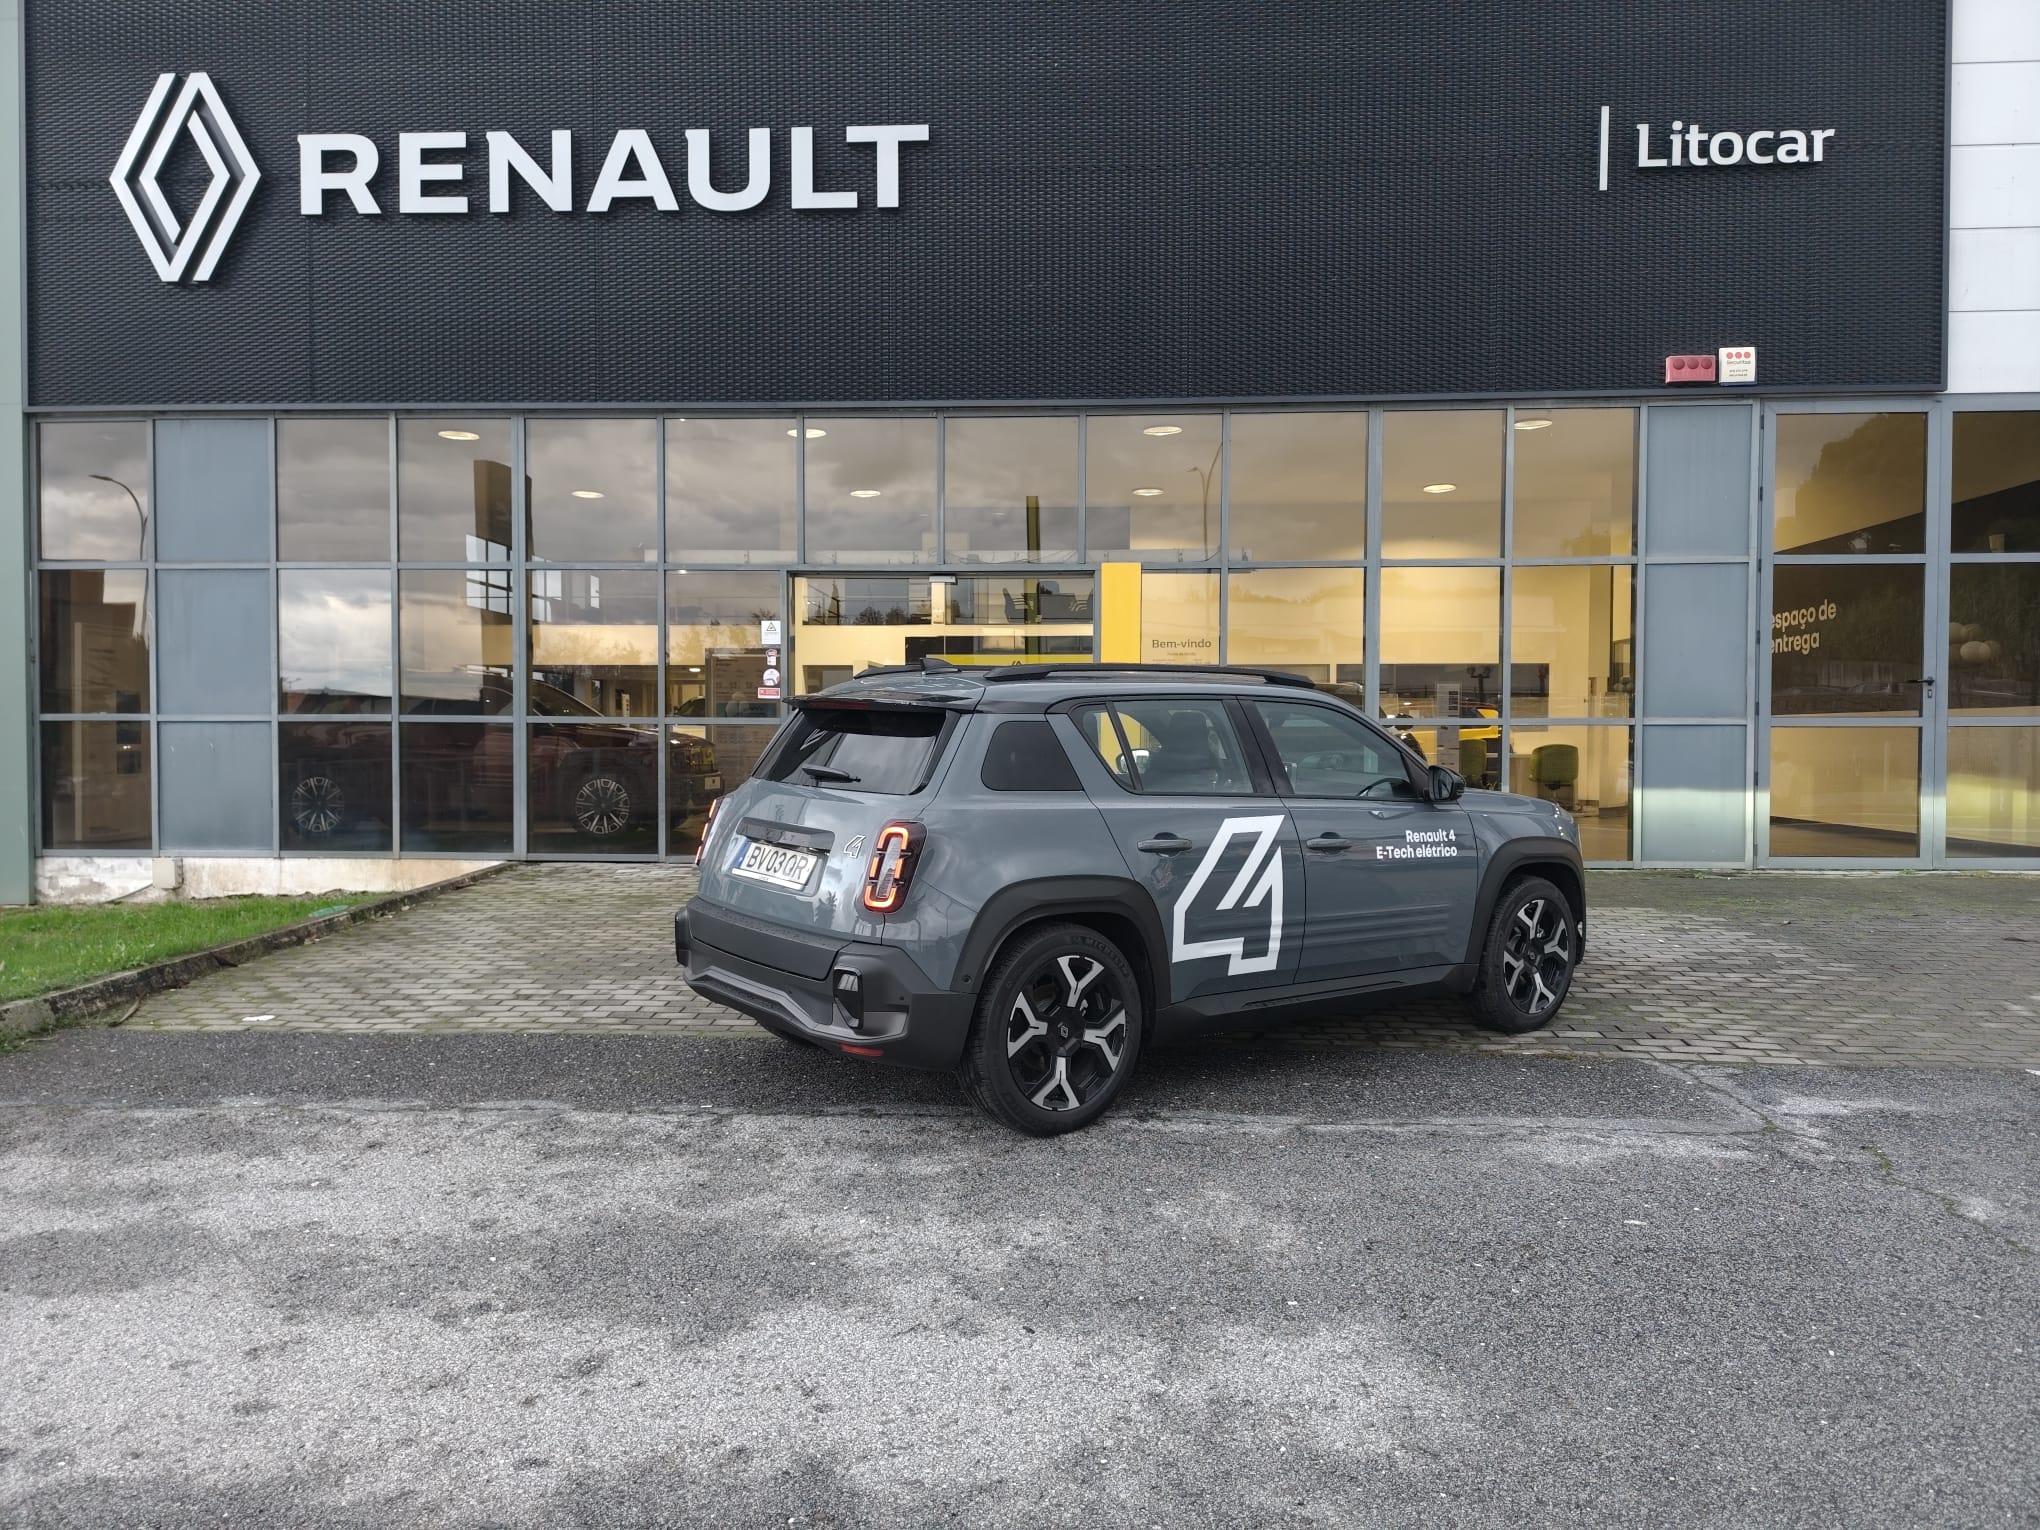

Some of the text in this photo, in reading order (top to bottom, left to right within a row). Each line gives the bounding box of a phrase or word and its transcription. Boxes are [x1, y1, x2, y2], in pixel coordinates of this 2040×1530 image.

[1636, 120, 1836, 168] Litocar
[297, 124, 930, 216] RENAULT
[1818, 598, 1837, 621] de
[1151, 638, 1212, 649] Bem-vindo
[1405, 828, 1457, 843] Renault 4
[1375, 843, 1458, 860] E-Tech elétrico
